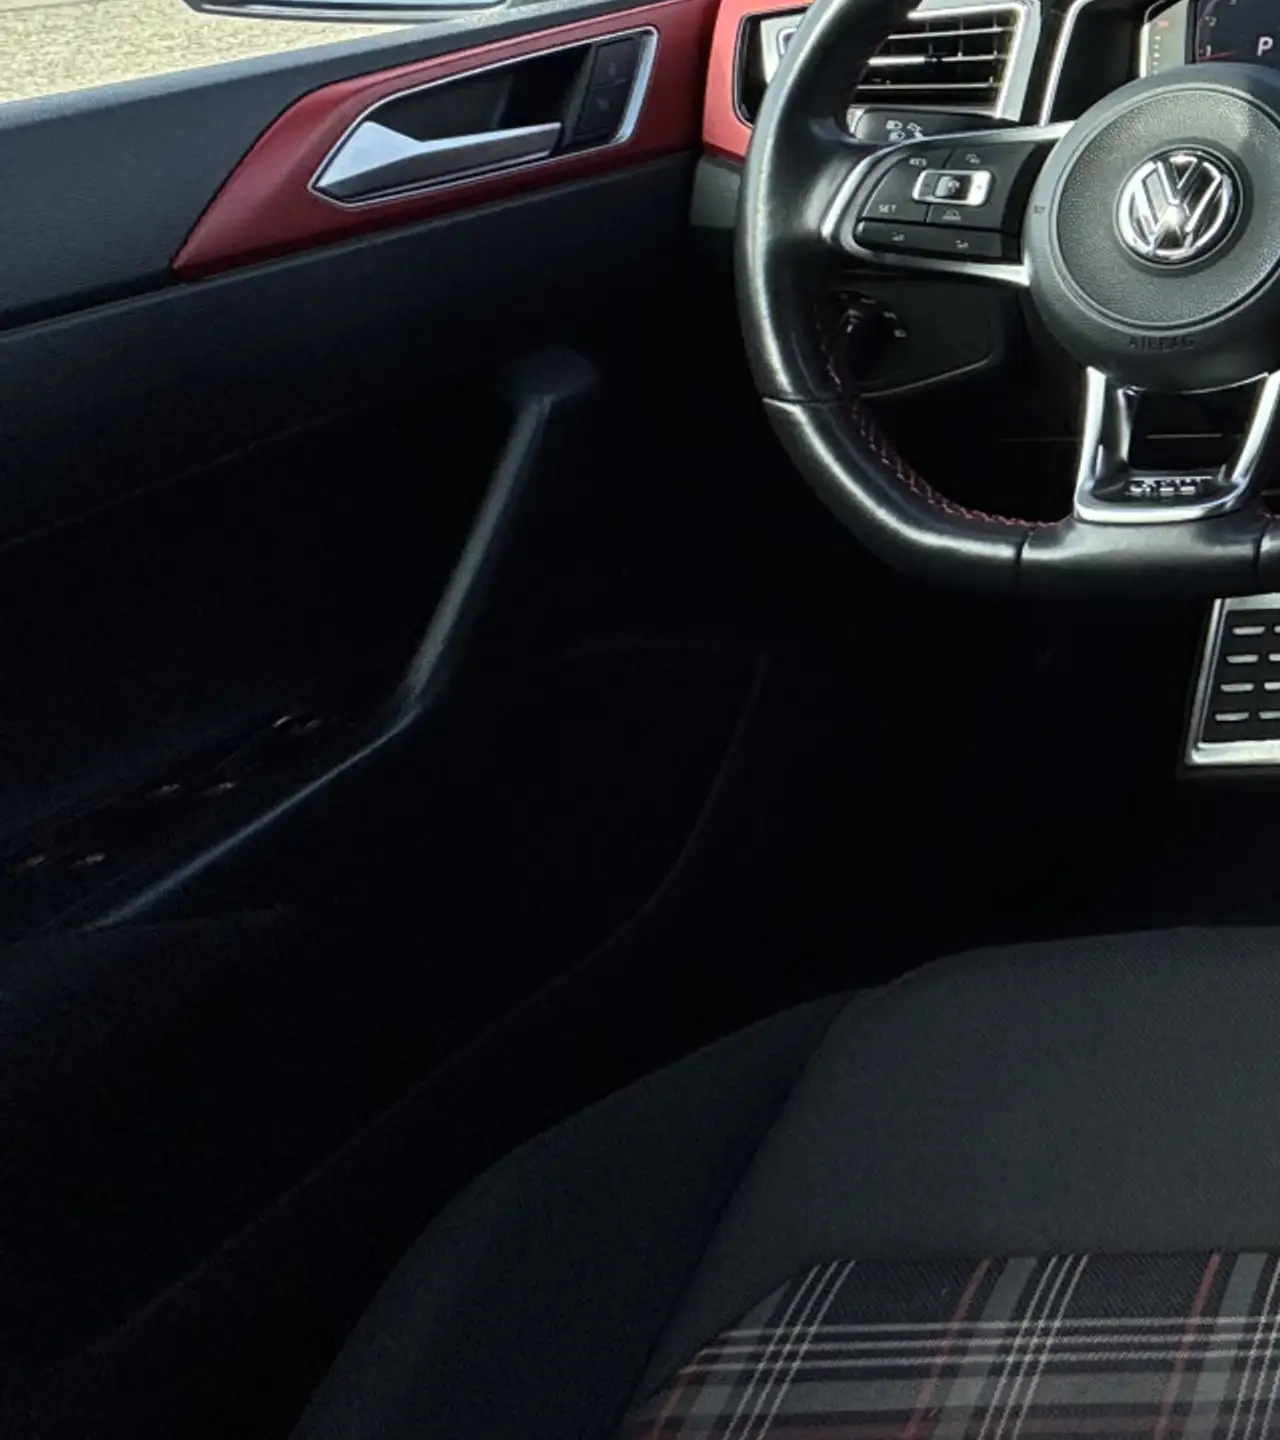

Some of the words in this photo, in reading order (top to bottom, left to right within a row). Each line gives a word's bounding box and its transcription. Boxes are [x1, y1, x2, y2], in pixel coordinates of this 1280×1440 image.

[1209, 17, 1218, 27] 2
[1256, 36, 1273, 56] P
[878, 204, 897, 213] SET
